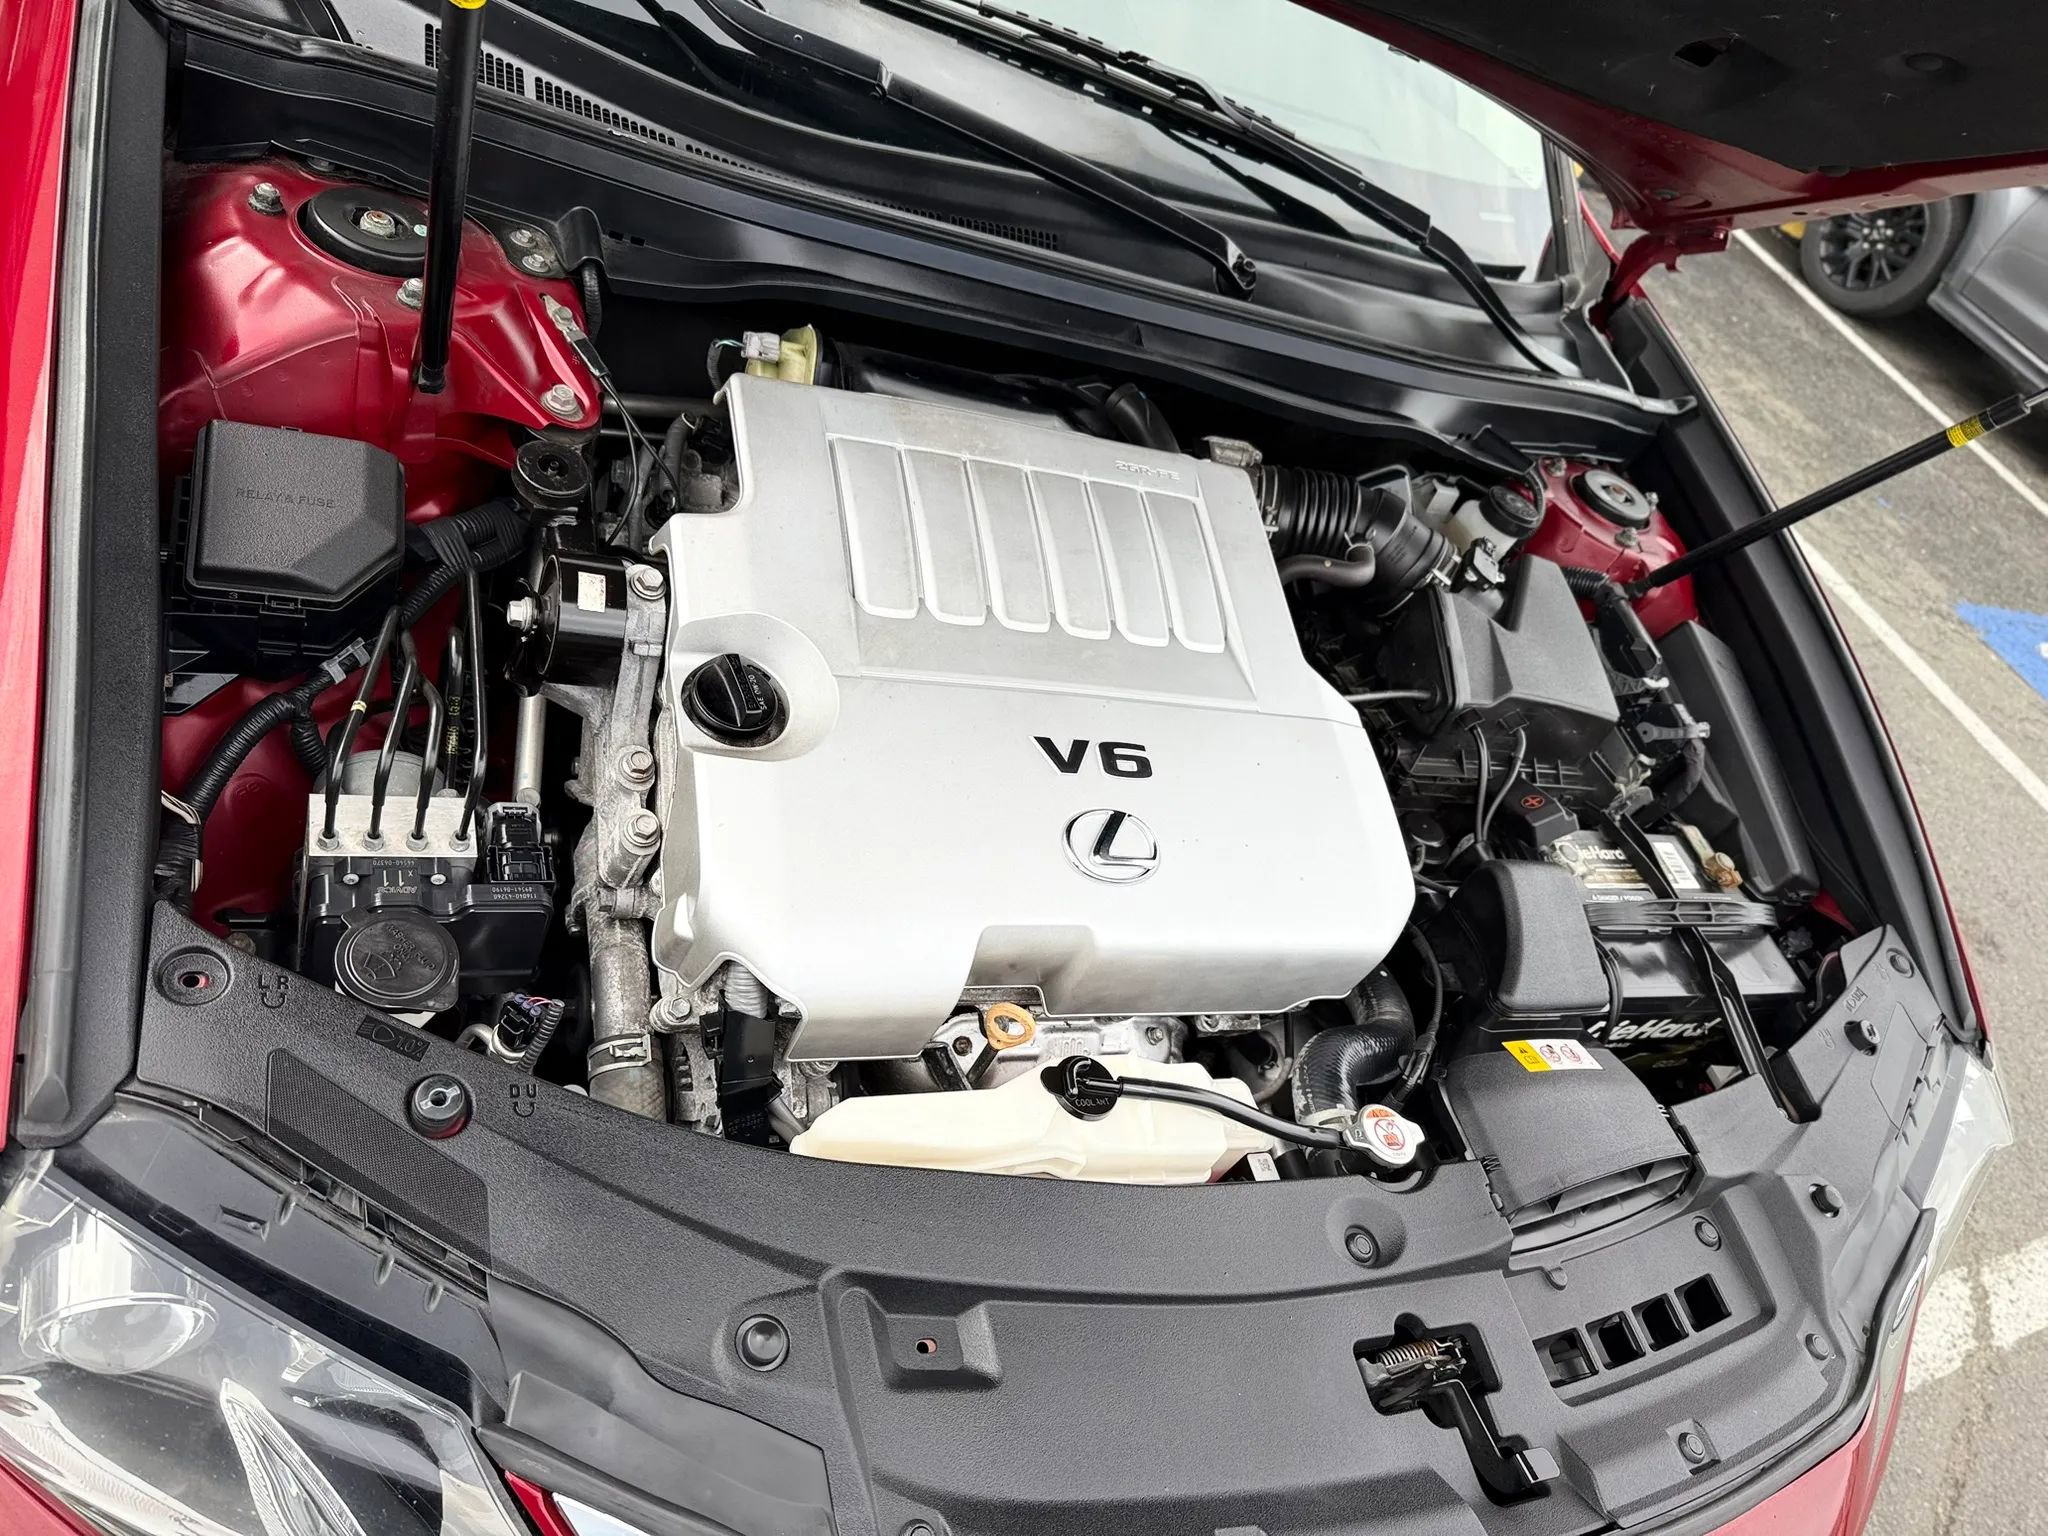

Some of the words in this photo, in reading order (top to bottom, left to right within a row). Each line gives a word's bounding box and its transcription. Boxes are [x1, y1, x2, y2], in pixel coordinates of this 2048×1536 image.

[299, 496, 337, 509] FUSE
[757, 697, 768, 710] SAE
[1031, 735, 1153, 779] V6
[376, 886, 418, 894] ADVICS
[1075, 1097, 1110, 1107] COOLANT
